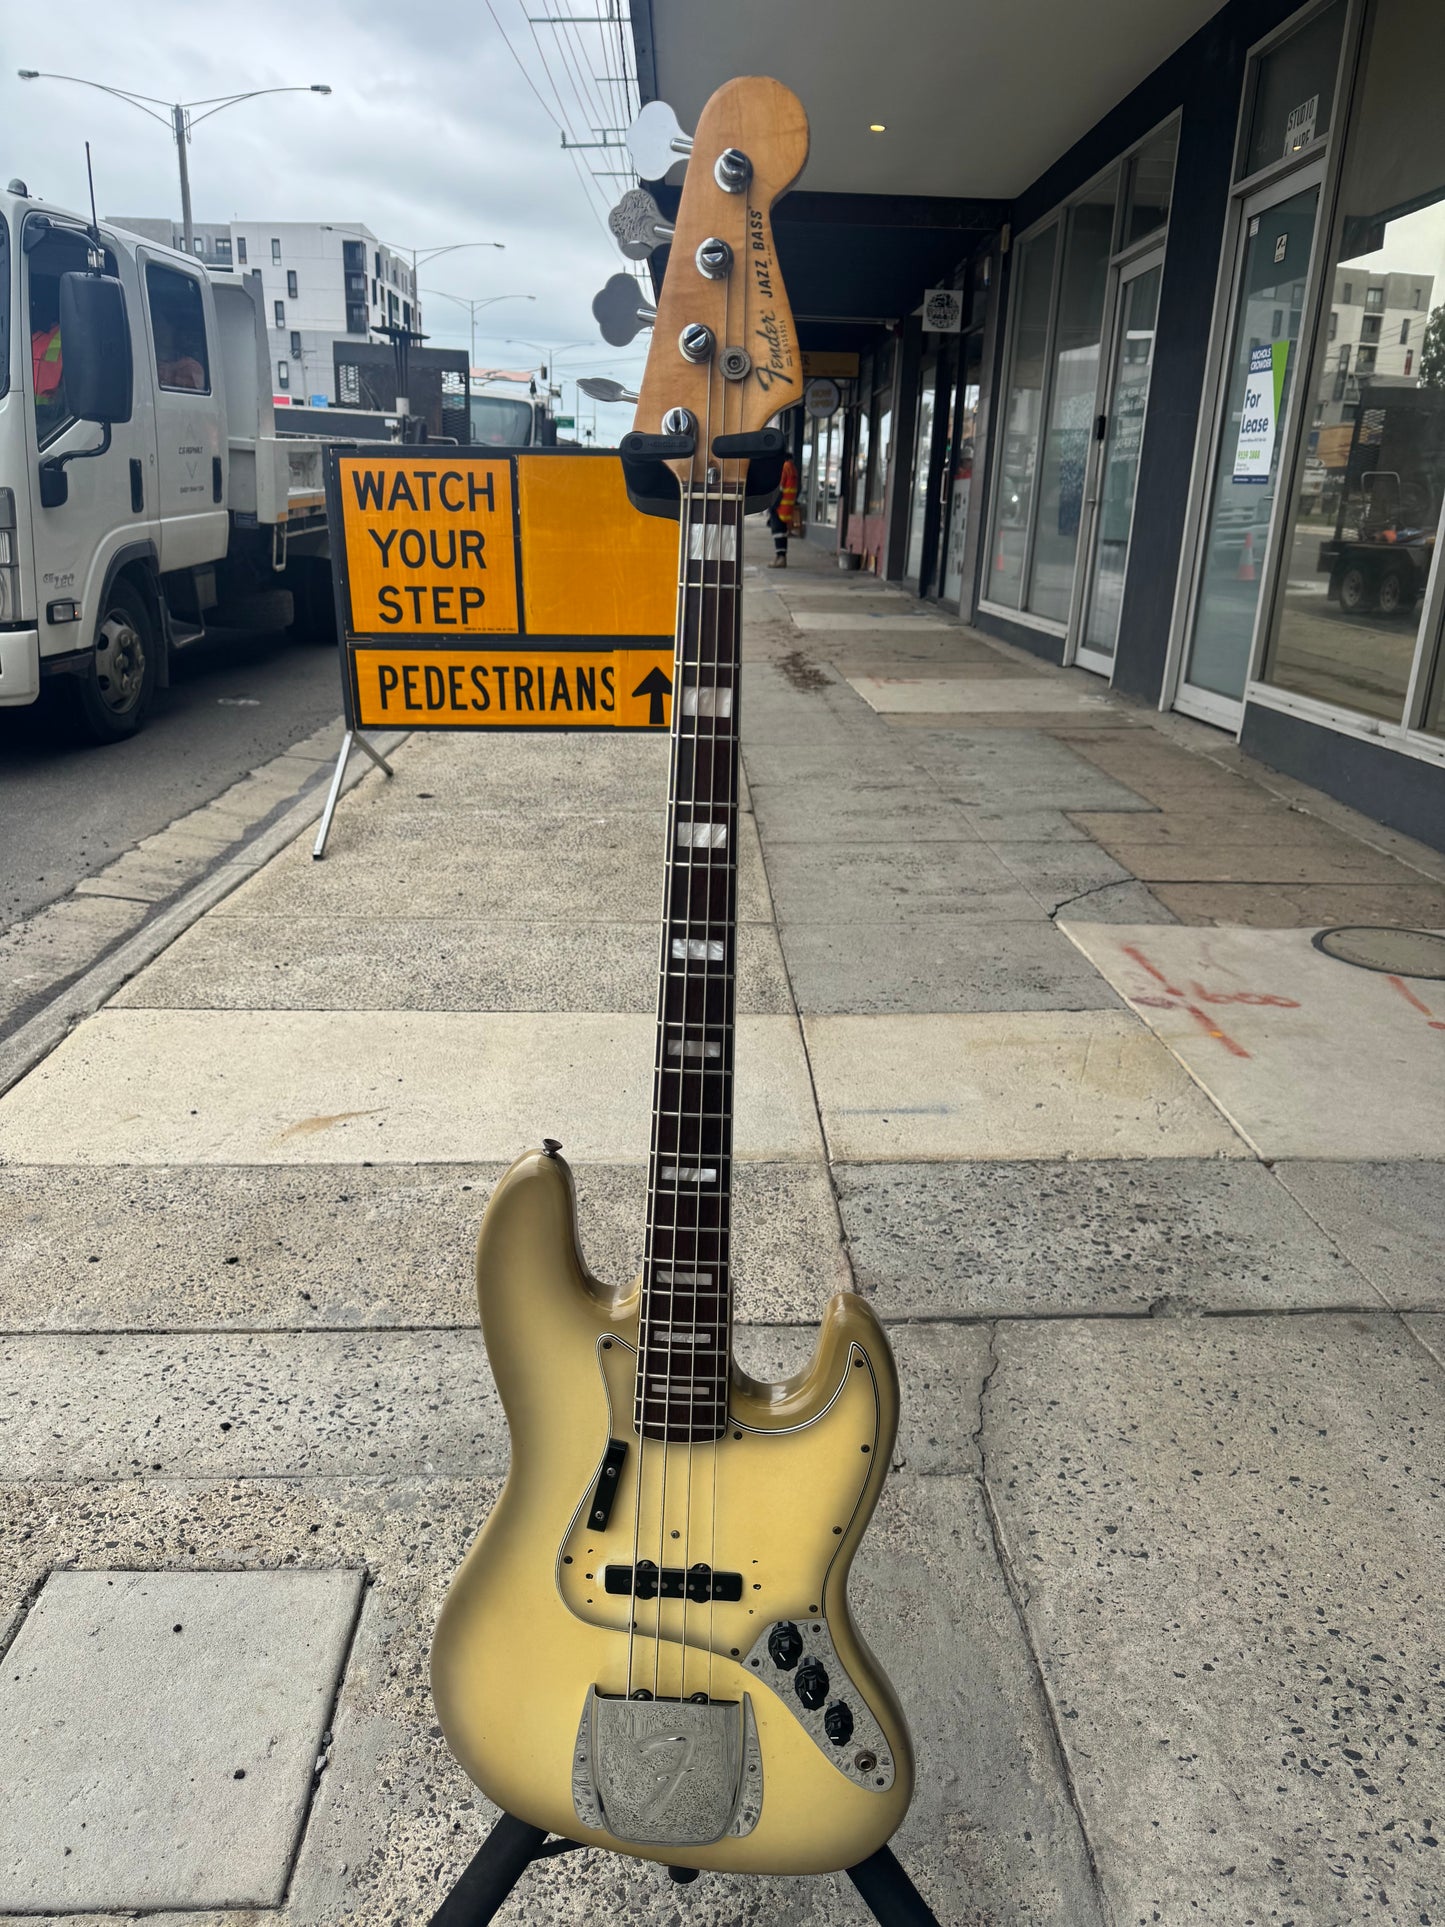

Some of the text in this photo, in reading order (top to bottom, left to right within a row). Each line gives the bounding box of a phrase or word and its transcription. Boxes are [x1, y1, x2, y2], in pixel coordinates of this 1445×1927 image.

[1287, 98, 1314, 131] STUDIO
[751, 210, 765, 250] BASS
[755, 260, 773, 298] JAZZ
[755, 310, 794, 391] Fender
[1250, 359, 1271, 370] CROWDER
[1252, 348, 1271, 359] NICHOLS
[1244, 389, 1262, 408] For
[1241, 415, 1269, 433] Lease
[352, 471, 495, 512] WATCH
[368, 529, 487, 569] YOUR
[378, 586, 485, 625] STEP
[378, 665, 615, 712] PEDESTRIANS
